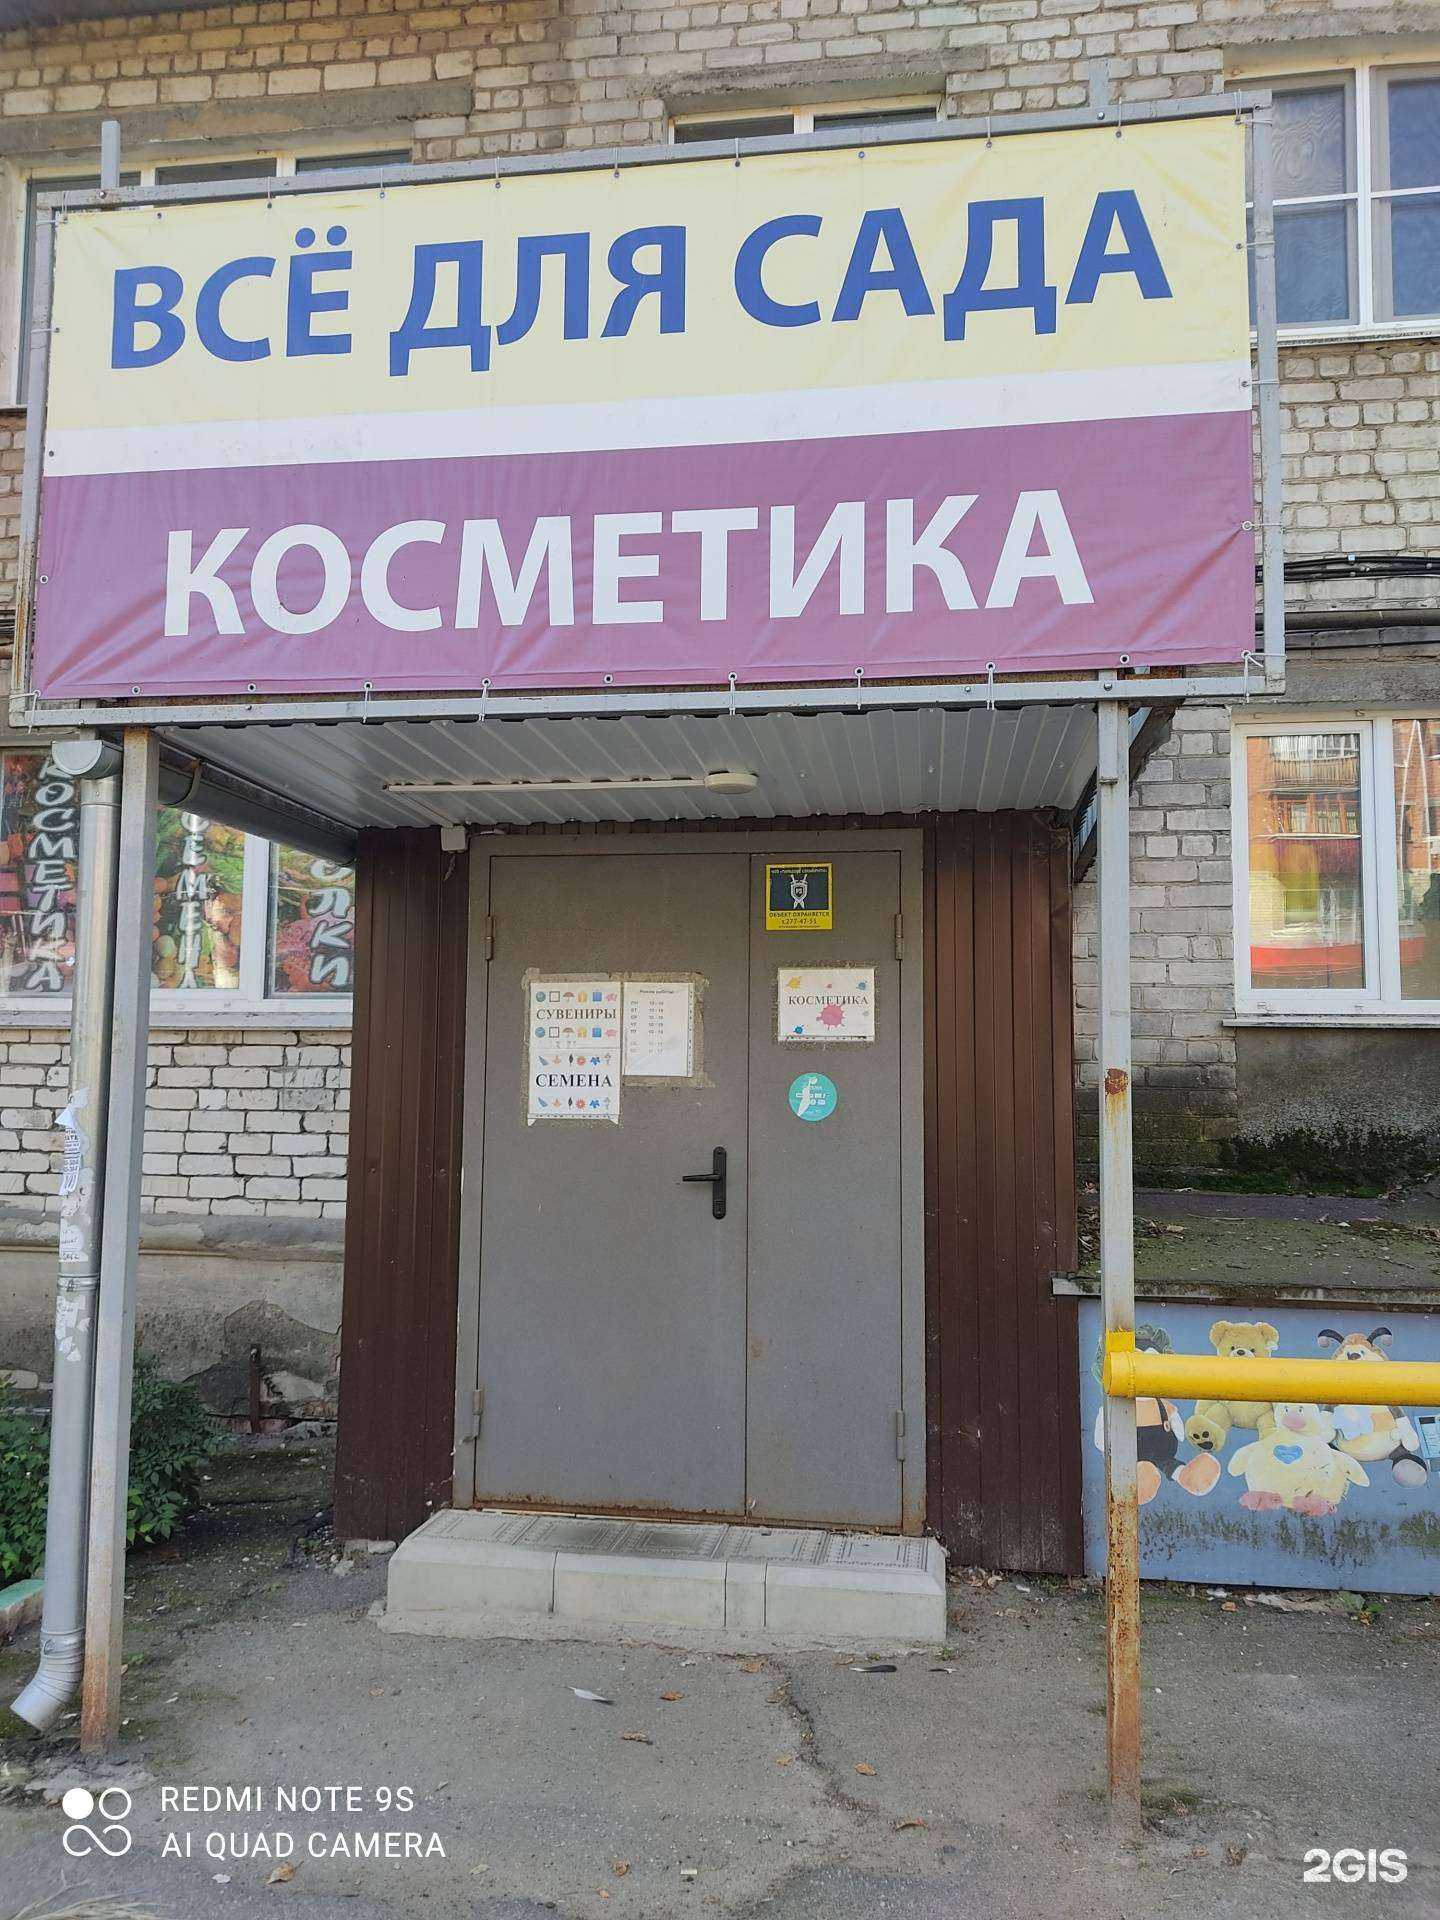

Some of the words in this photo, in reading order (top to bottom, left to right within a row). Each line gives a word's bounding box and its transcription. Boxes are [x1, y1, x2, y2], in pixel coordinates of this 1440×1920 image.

[112, 226, 353, 369] ВСЁ
[390, 226, 686, 376] ДЛЯ
[735, 190, 1172, 341] САДА
[164, 489, 1095, 637] КОСМЕТИКА
[788, 995, 869, 1006] КОСМЕТИКА
[536, 1008, 617, 1020] СУВЕНИРЫ
[535, 1073, 613, 1088] СЕМЕНА
